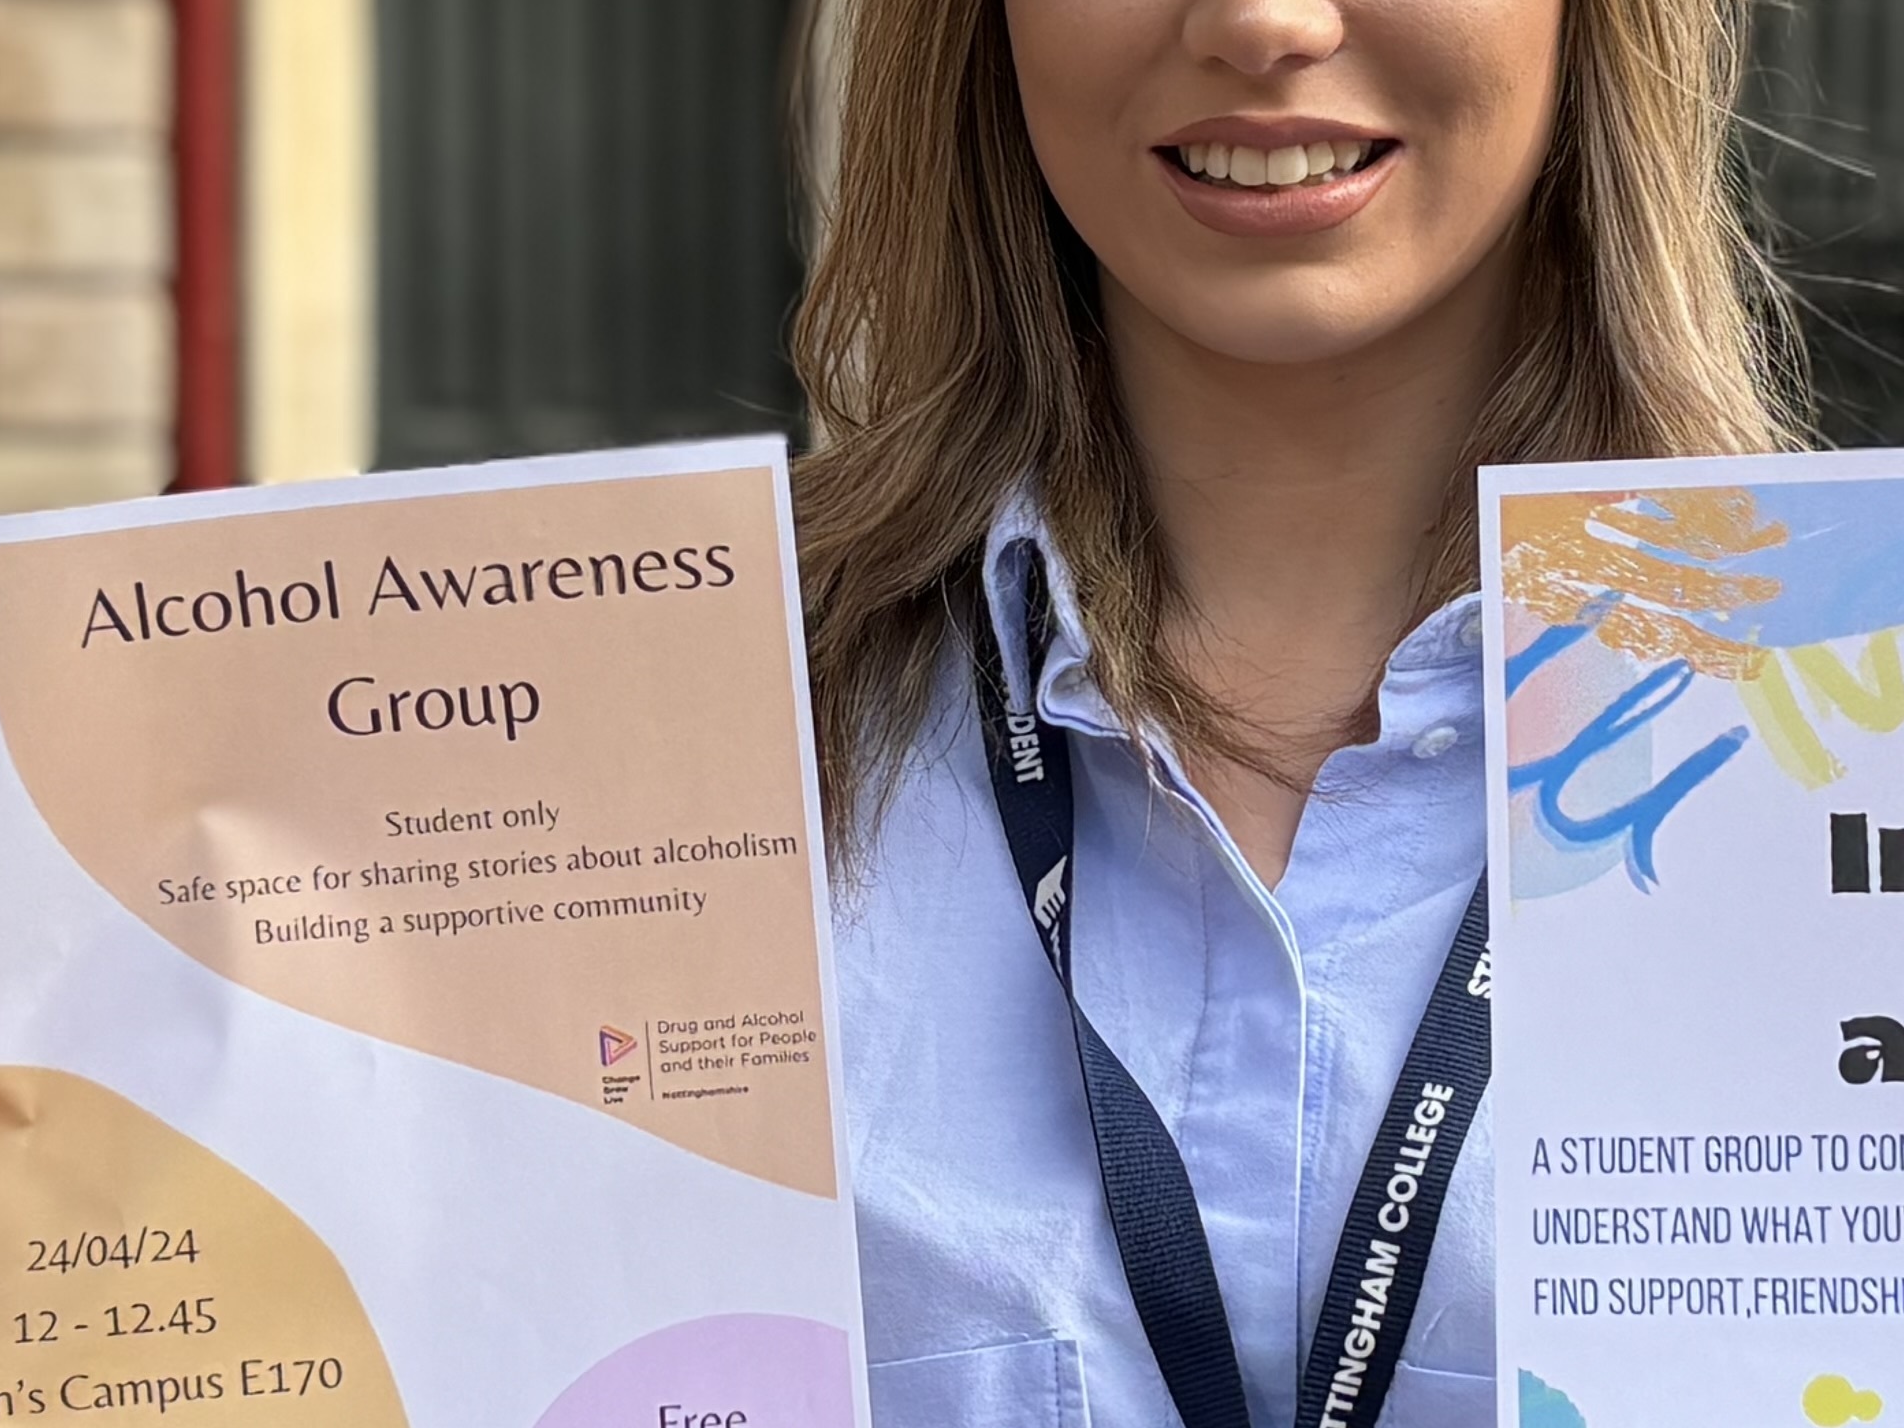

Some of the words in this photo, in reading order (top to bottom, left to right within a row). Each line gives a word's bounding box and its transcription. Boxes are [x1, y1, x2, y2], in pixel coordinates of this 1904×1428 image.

[81, 560, 340, 649] Alcohol
[368, 545, 735, 616] Awareness
[326, 676, 541, 742] Group
[1006, 713, 1045, 784] DENT
[385, 807, 493, 837] Student
[502, 799, 560, 832] only
[158, 875, 216, 905] Safe
[225, 875, 302, 904] space
[312, 864, 352, 891] for
[360, 858, 460, 889] sharing
[467, 850, 557, 879] stories
[566, 844, 642, 872] about
[653, 832, 797, 865] alcoholism
[255, 914, 370, 945] Building
[379, 915, 395, 934] a
[403, 900, 544, 937] supportive
[553, 887, 707, 921] community
[657, 1020, 699, 1035] Drug
[703, 1014, 736, 1032] and
[741, 1010, 804, 1028] Alcohol
[658, 1036, 726, 1055] Support
[731, 1033, 754, 1048] for
[759, 1029, 817, 1046] People
[660, 1056, 693, 1074] and
[697, 1055, 735, 1071] their
[740, 1050, 810, 1067] Families
[1378, 1081, 1455, 1232] COLLEGE
[1531, 1137, 1552, 1175] A
[1560, 1136, 1696, 1175] STUDENT
[1704, 1134, 1803, 1173] GROUP
[1810, 1134, 1849, 1173] TO
[1533, 1206, 1732, 1245] UNDERSTAND
[1740, 1205, 1832, 1245] WHAT
[26, 1226, 201, 1275] 24/04/24
[13, 1310, 59, 1344] 12
[103, 1297, 217, 1337] 12.45
[1534, 1277, 1599, 1316] FIND
[59, 1373, 224, 1415] Campus
[240, 1357, 343, 1396] E170
